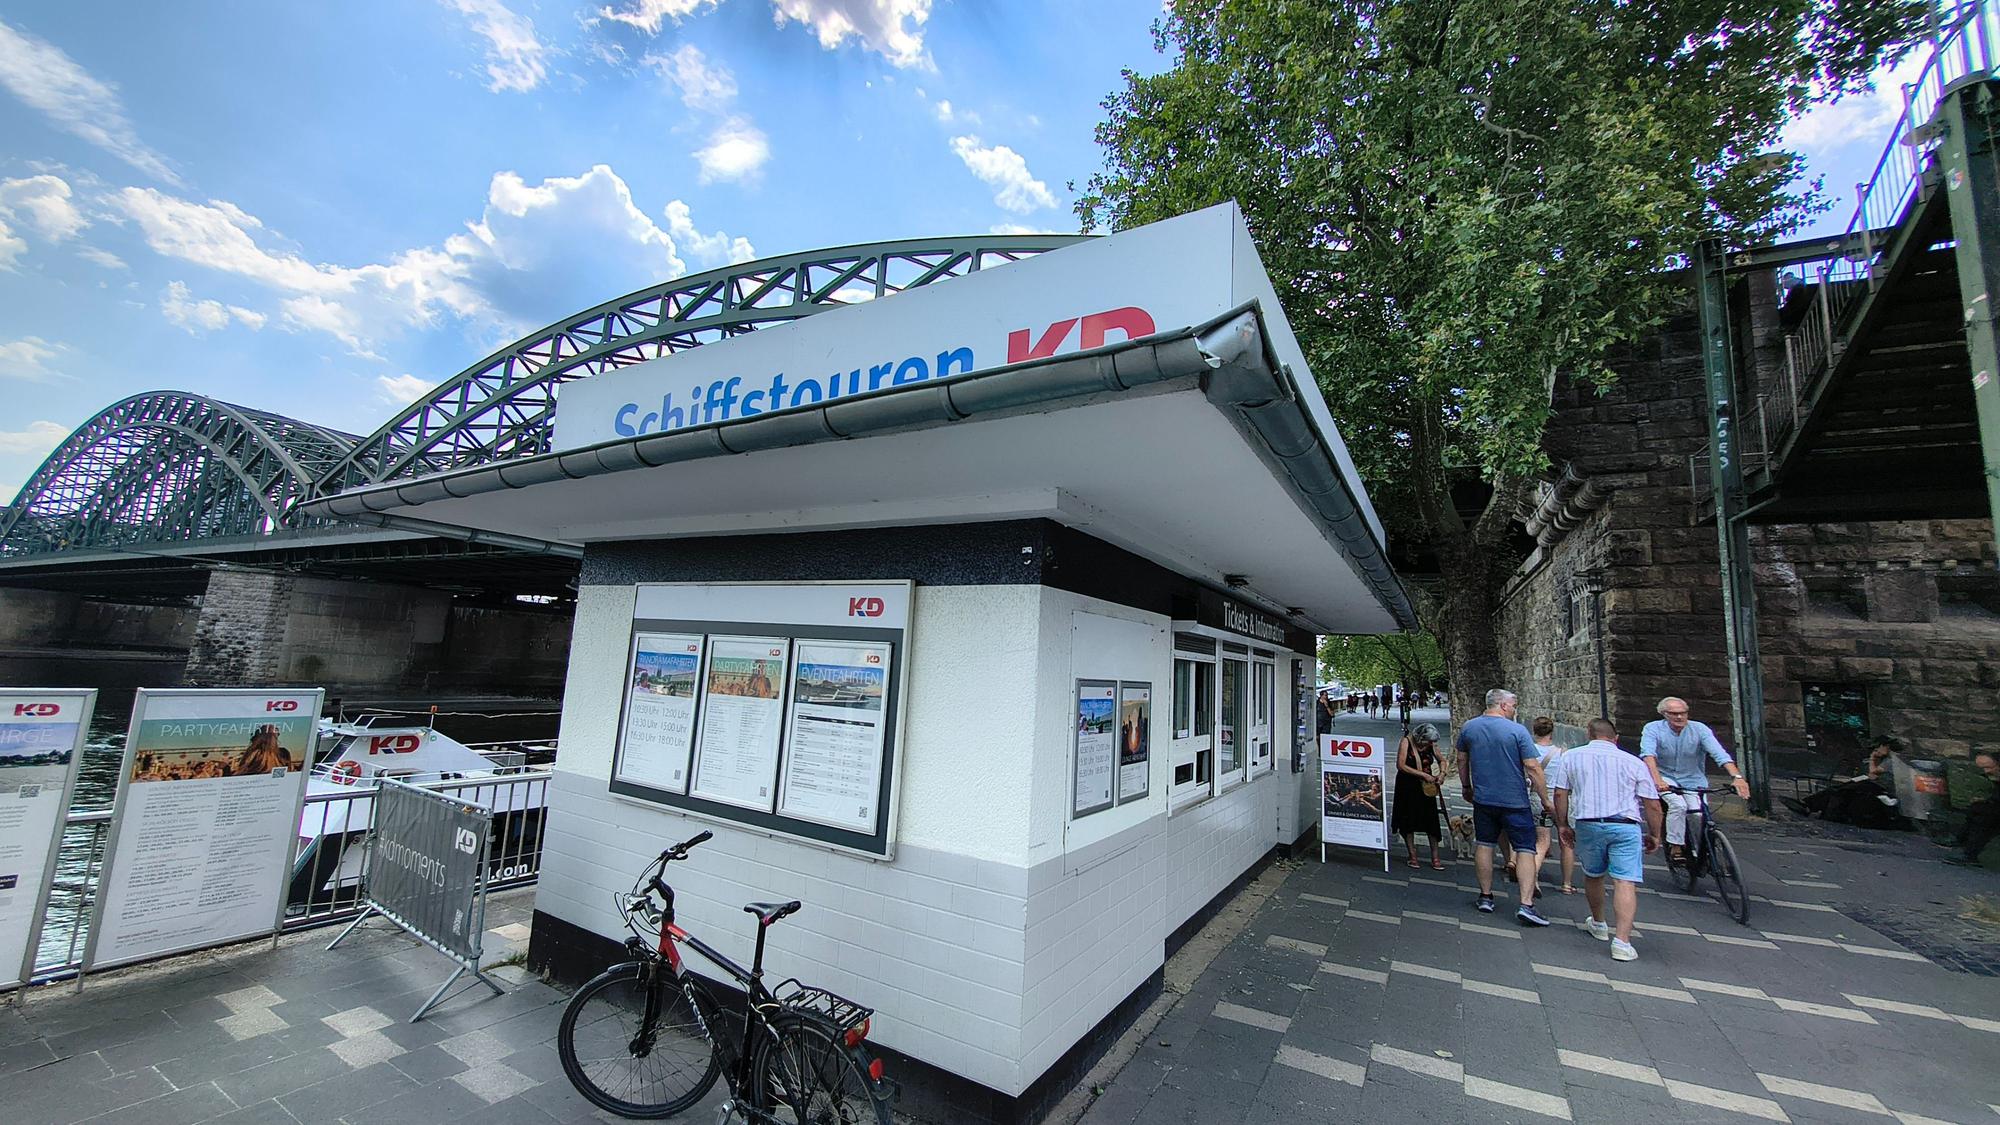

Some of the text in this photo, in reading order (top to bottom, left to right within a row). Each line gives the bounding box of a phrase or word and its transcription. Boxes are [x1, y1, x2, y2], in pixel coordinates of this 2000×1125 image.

[614, 306, 1156, 438] Schiffstouren KD
[848, 597, 885, 617] KD
[1223, 601, 1285, 643] Tickets & Information
[768, 648, 781, 656] KD
[866, 655, 881, 664] KD
[801, 667, 880, 685] EVENTFAHRTEN
[14, 703, 61, 717] KD
[266, 700, 298, 712] KD
[0, 728, 54, 744] IRGE
[160, 721, 294, 737] PARTYFAHRTEN
[369, 735, 421, 755] KD
[1331, 740, 1372, 758] KD
[455, 826, 478, 855] KD
[378, 830, 446, 888] #kdmoments
[487, 863, 528, 881] .com
